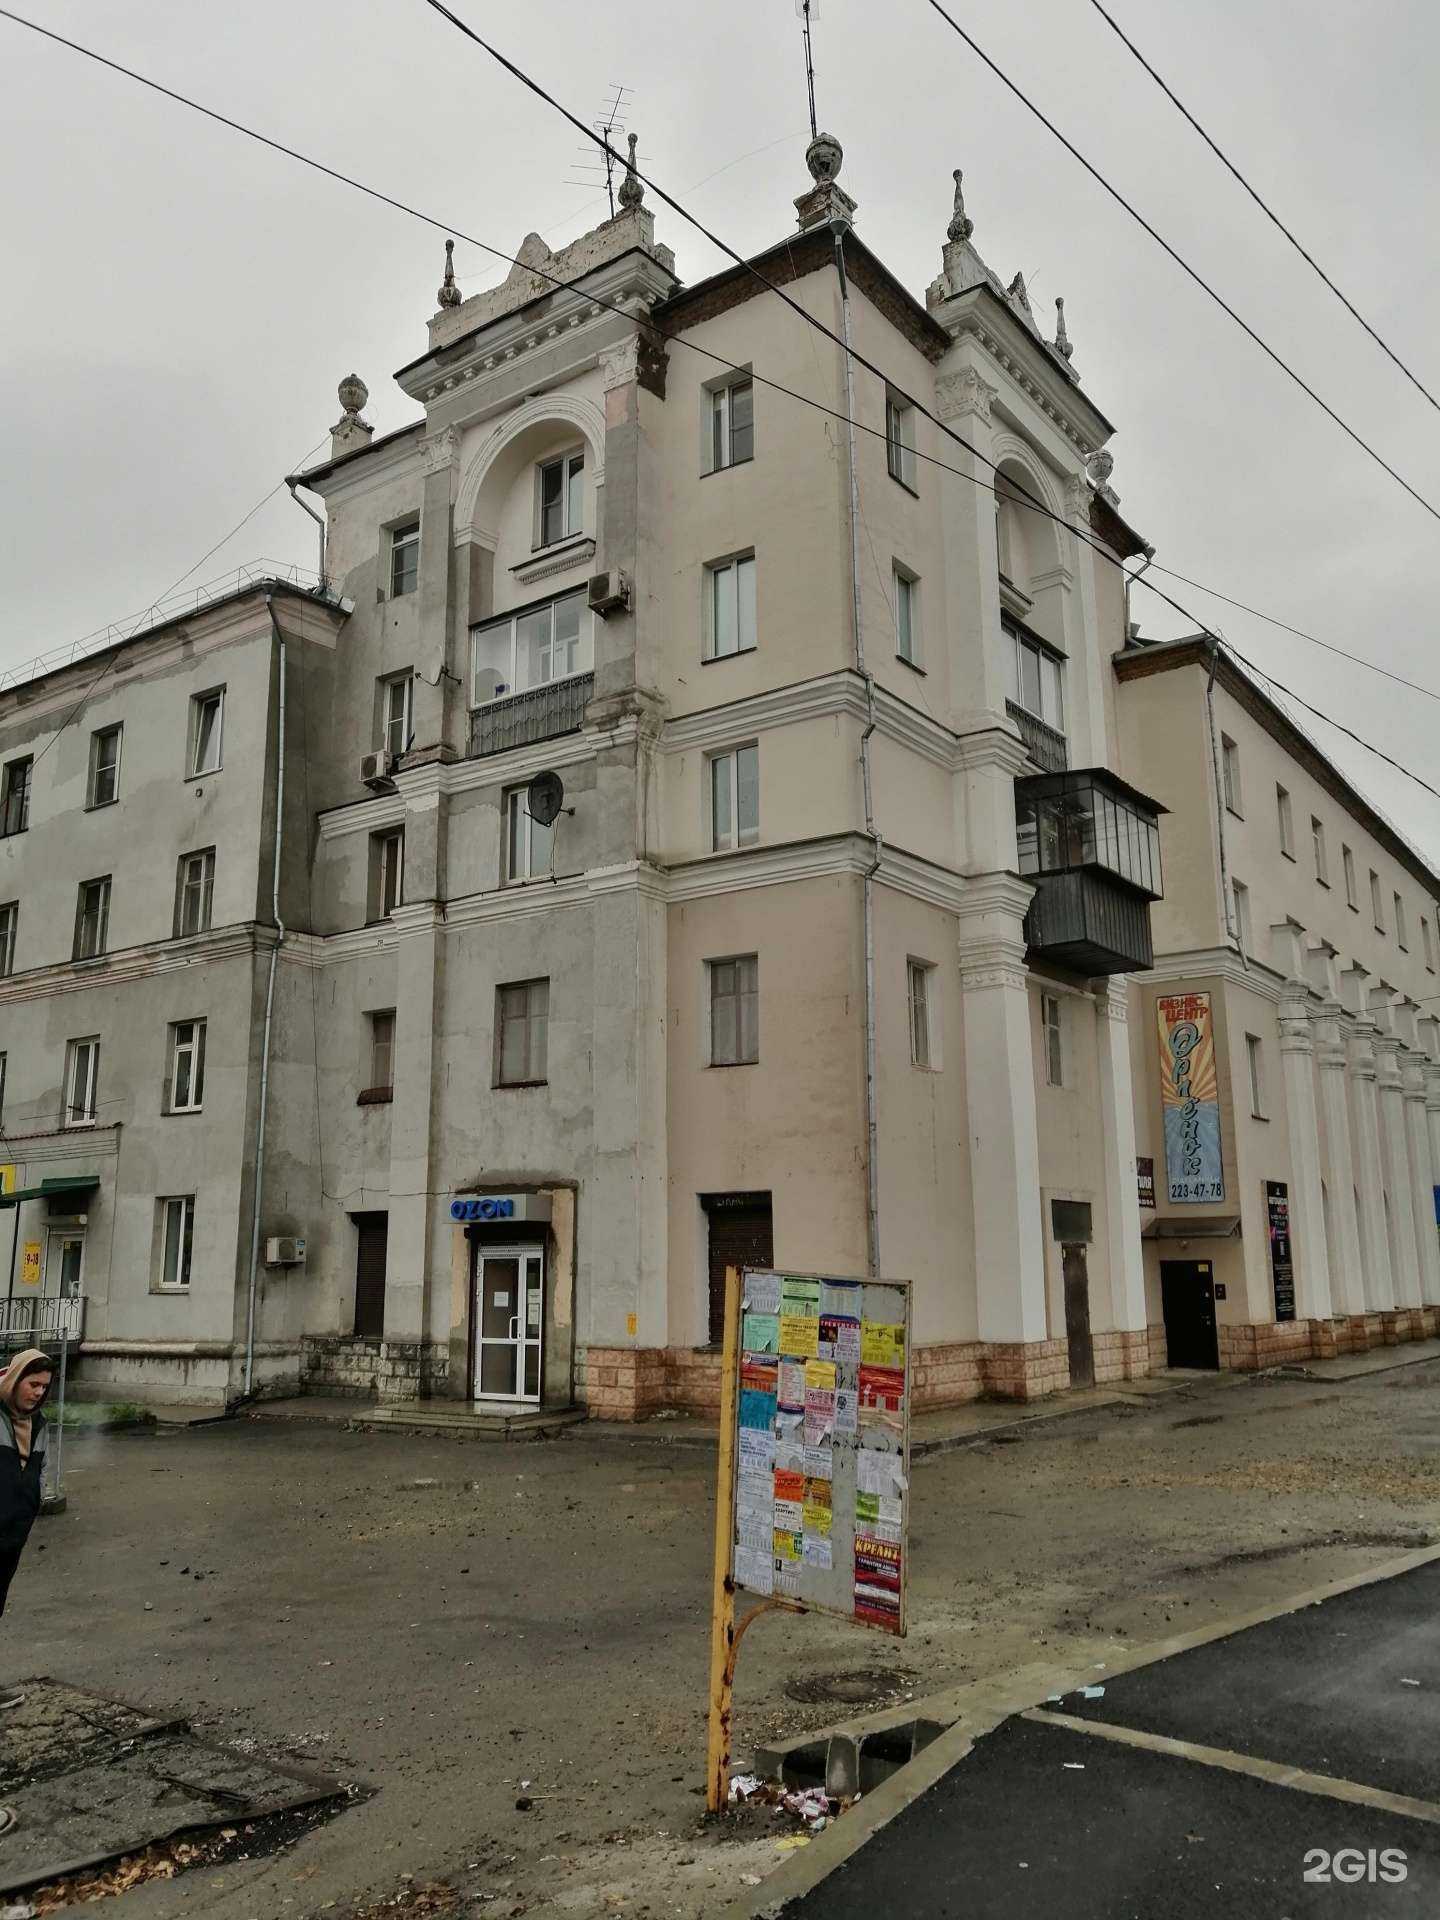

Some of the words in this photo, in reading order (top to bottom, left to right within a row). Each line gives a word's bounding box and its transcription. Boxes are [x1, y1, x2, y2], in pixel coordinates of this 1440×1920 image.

[1159, 996, 1204, 1010] БИЗНЕС
[1166, 1006, 1209, 1023] ЦЕНТР
[1171, 1184, 1222, 1198] 223-47-78
[450, 1199, 513, 1219] OZON
